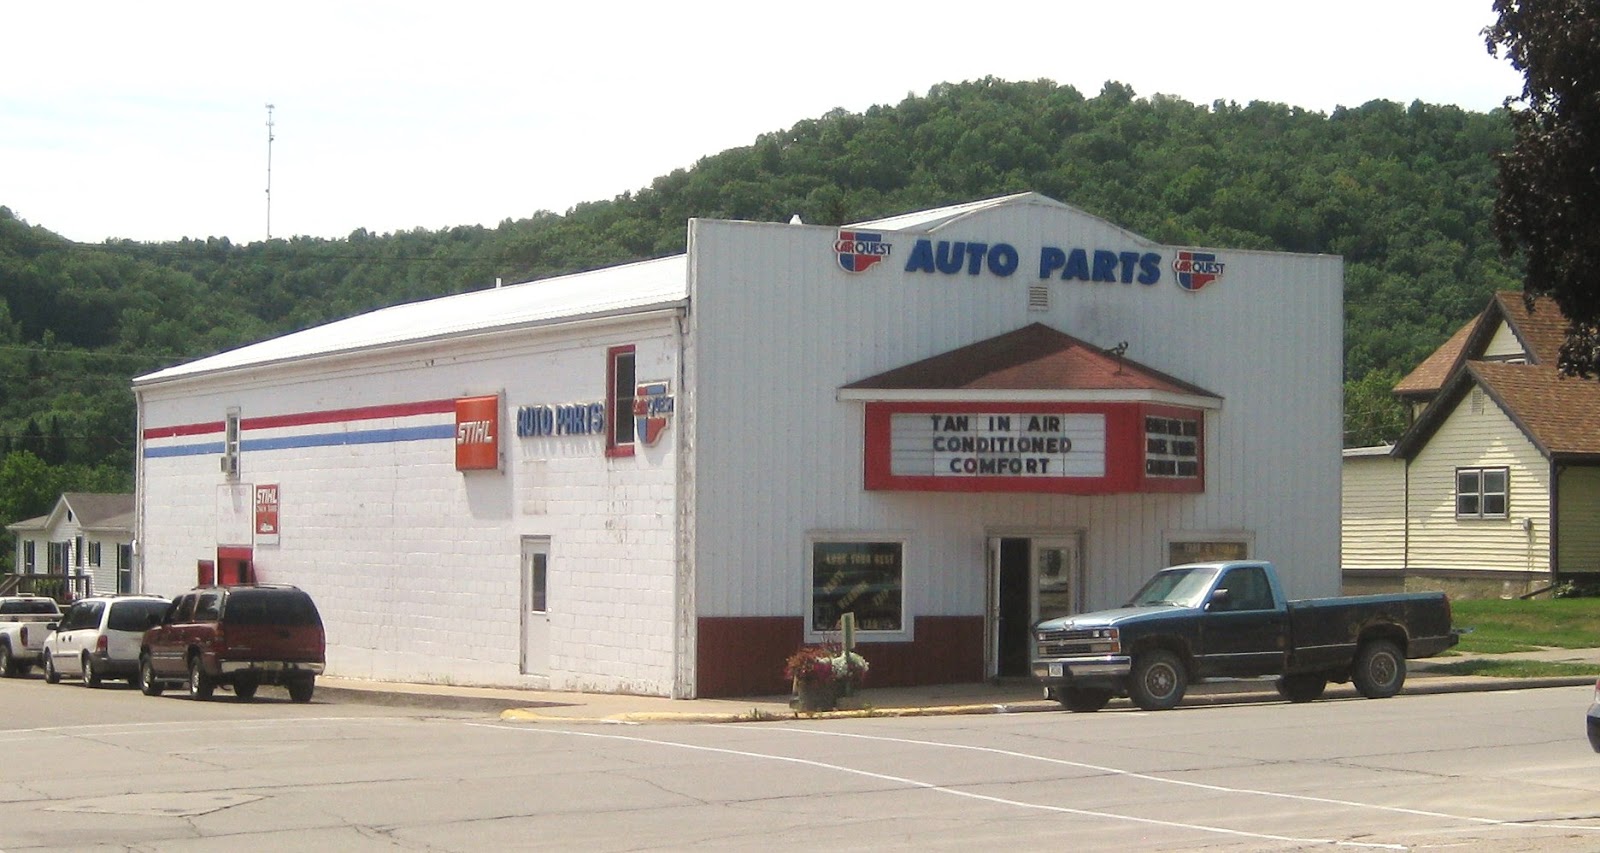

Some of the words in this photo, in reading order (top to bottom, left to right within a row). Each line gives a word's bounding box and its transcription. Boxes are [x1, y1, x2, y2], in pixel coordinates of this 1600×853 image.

[834, 240, 892, 255] CARQUEST
[904, 239, 1019, 277] AUTO
[1039, 246, 1162, 285] PARTS
[1174, 259, 1225, 275] CARQUEST
[517, 404, 553, 437] AUTO
[556, 402, 604, 436] PARTS
[931, 415, 969, 431] TAN
[989, 415, 1011, 431] IN
[1027, 415, 1060, 431] AIR
[457, 421, 493, 444] STIHL
[932, 437, 1072, 454] CONDITIONED
[950, 457, 1050, 475] COMFORT
[257, 488, 277, 504] STIHL
